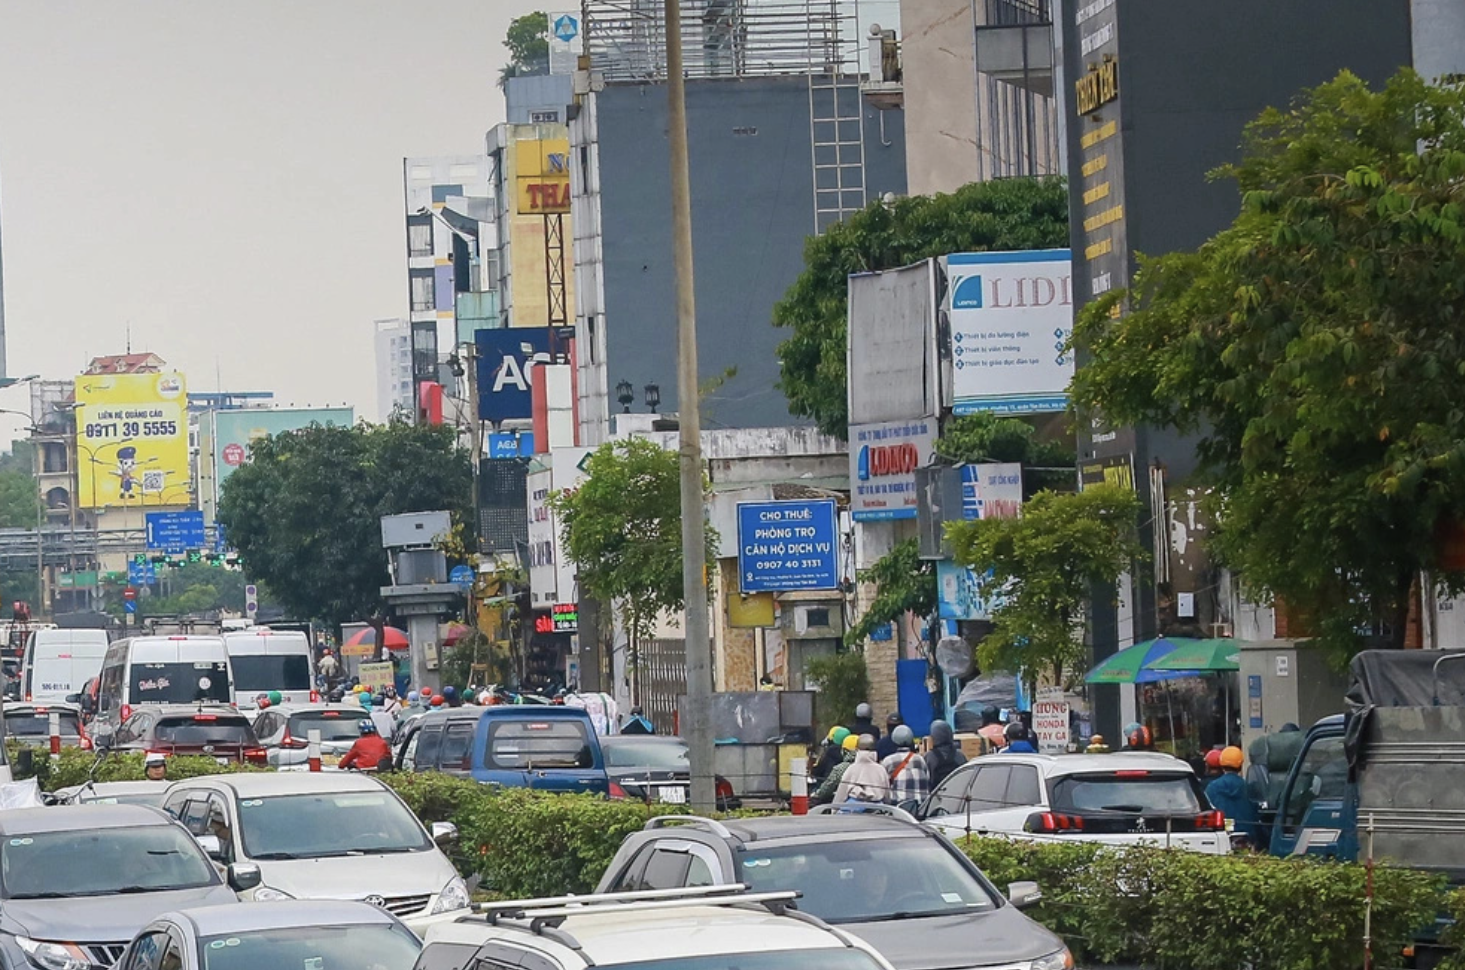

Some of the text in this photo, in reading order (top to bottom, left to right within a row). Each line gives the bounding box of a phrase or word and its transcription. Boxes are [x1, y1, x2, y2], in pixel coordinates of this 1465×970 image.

[492, 355, 532, 392] A
[98, 410, 113, 420] LIÊN
[125, 409, 147, 419] QUẢNG
[149, 409, 163, 418] CÁO
[123, 422, 139, 437] 39
[143, 421, 176, 436] 5555
[759, 507, 812, 521] CHO THUÊ:
[755, 526, 816, 540] PHÒNG TRỌ
[745, 541, 830, 557] CĂN HỘ DỊCH VỤ
[756, 559, 822, 570] 0907 40 3131
[1037, 720, 1065, 729] HONDA
[1037, 731, 1066, 741] TAY GA
